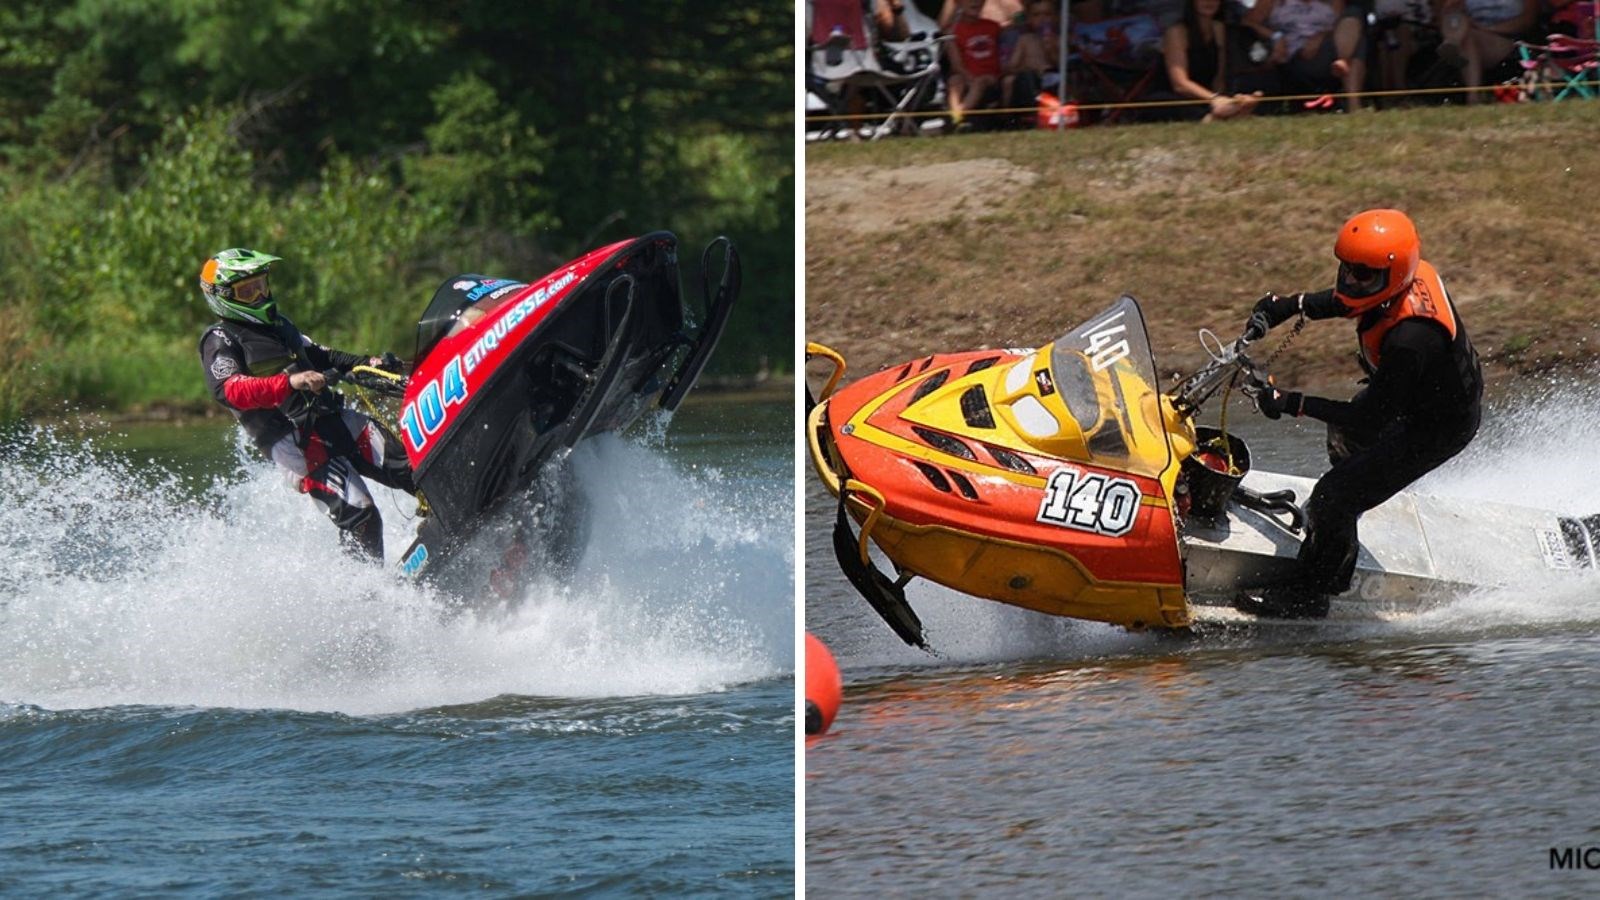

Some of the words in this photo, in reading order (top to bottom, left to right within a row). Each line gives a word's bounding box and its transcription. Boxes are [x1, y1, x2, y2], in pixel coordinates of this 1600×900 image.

[463, 272, 575, 374] ETIQUESSE.com
[1080, 310, 1130, 372] 140
[401, 355, 468, 452] 104
[1037, 467, 1142, 537] 140
